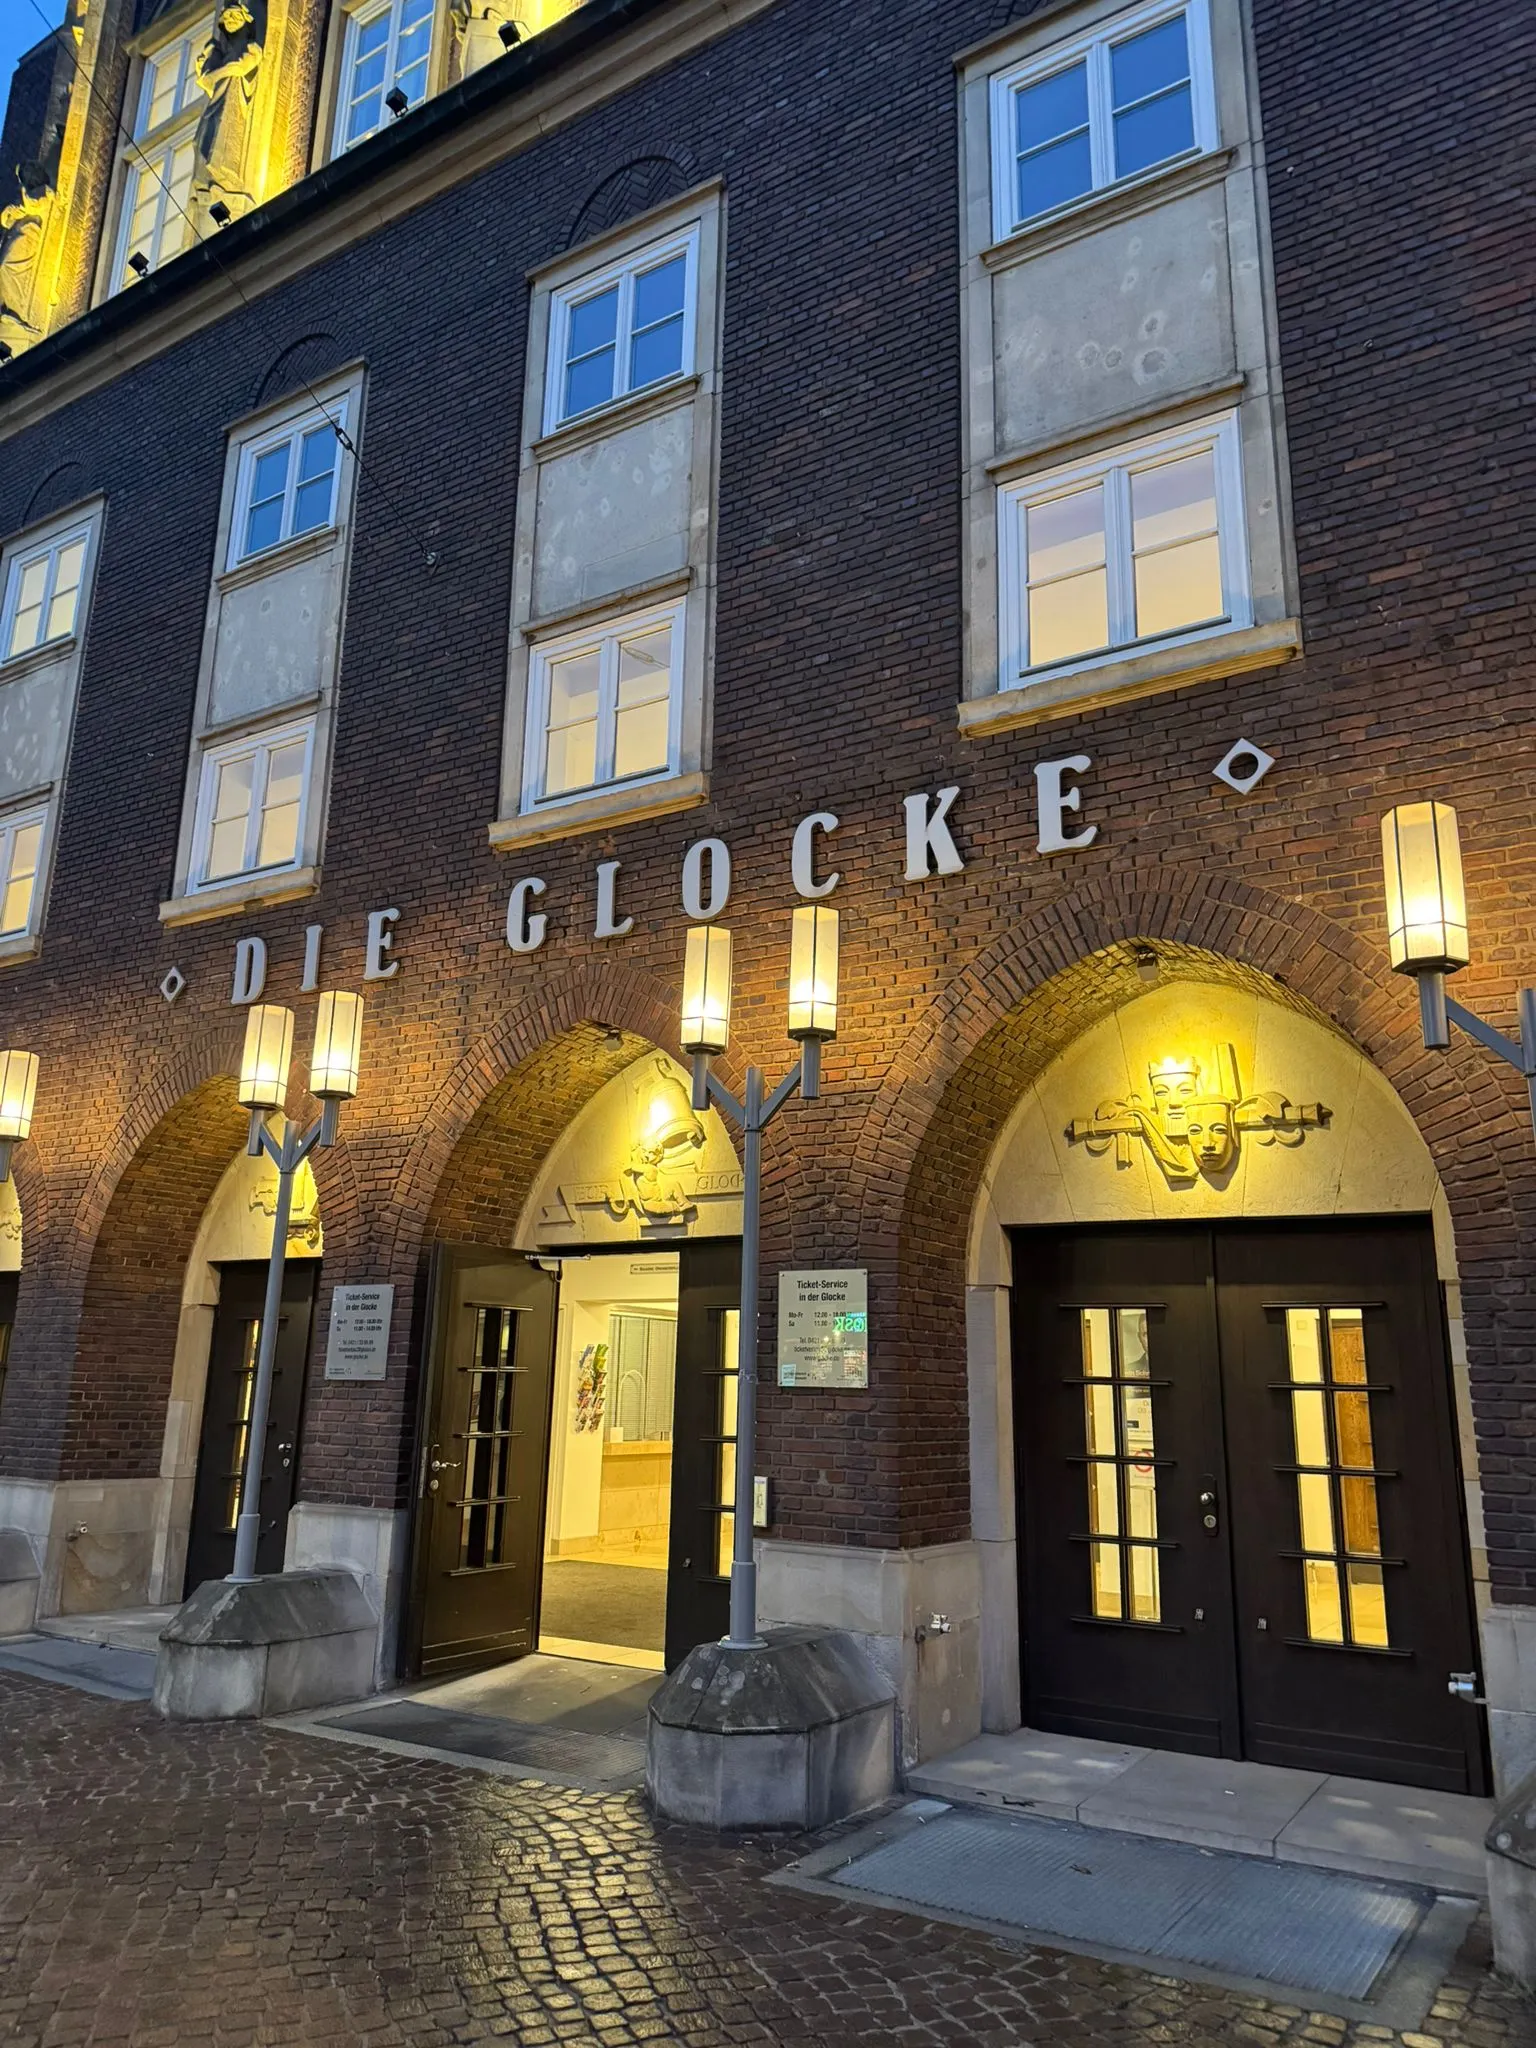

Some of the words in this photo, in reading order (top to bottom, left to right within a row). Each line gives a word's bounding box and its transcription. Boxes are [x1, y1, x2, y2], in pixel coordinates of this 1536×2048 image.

[231, 907, 400, 1004] DIE
[506, 754, 1098, 952] GLOCKE
[797, 1280, 848, 1289] Ticket-Service
[345, 1293, 380, 1301] Ticket-Service
[799, 1292, 806, 1301] in
[808, 1292, 819, 1301] der
[821, 1292, 846, 1301] Glocke
